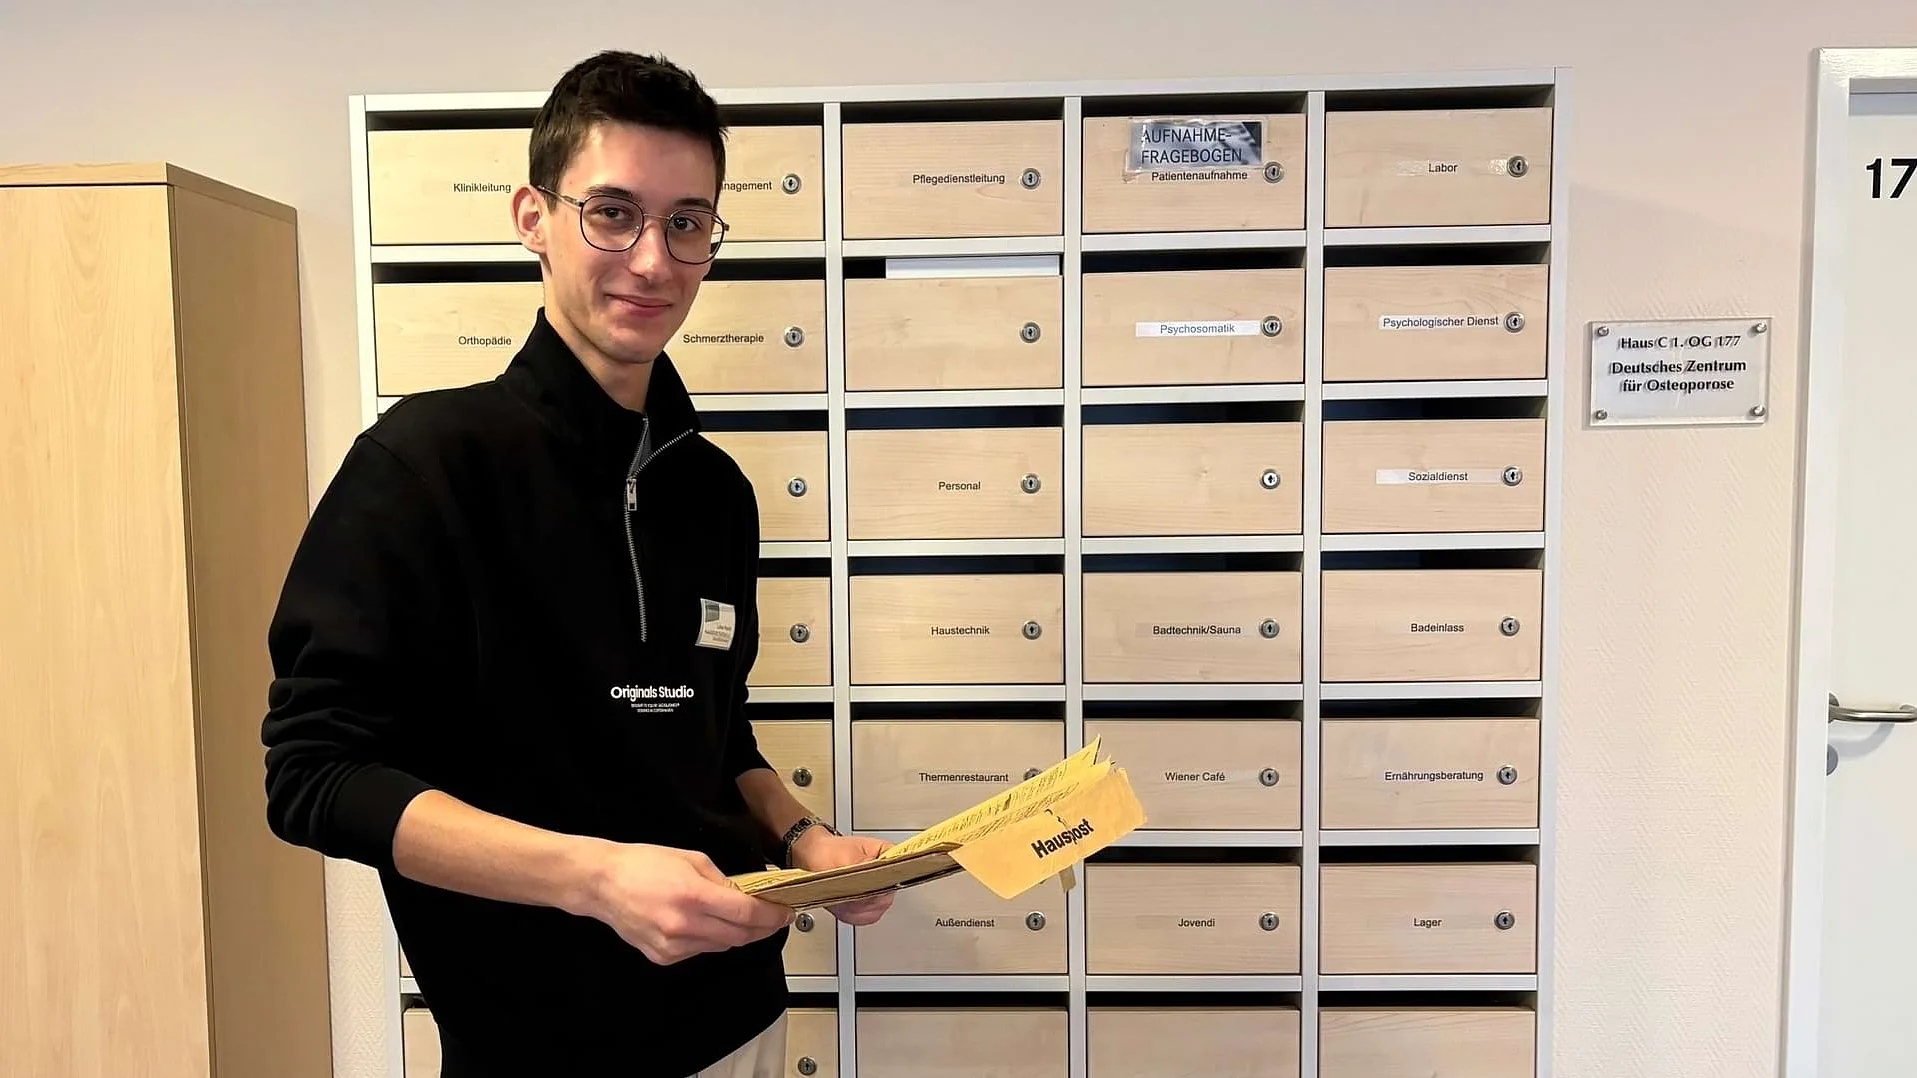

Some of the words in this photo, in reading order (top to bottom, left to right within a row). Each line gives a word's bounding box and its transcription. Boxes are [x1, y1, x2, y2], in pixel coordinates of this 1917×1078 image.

[1141, 127, 1232, 144] AUFNAHME-
[1141, 147, 1243, 164] FRAGEBOGEN
[1427, 162, 1459, 174] Labor
[912, 173, 1006, 186] Pflegedienstleitung
[1151, 170, 1249, 182] Patientenaufnahme
[452, 182, 512, 194] Klinikleitung
[722, 181, 773, 193] nagement
[1382, 316, 1464, 329] Psychologischer
[1466, 314, 1500, 327] Dienst
[1159, 323, 1236, 336] Psychosomatik
[457, 335, 513, 348] Orthopädie
[682, 333, 765, 346] Schmerztherapie
[1620, 337, 1654, 349] Haus
[1657, 337, 1668, 348] C
[1688, 336, 1712, 347] OG
[1717, 335, 1741, 346] 177
[1611, 360, 1683, 374] Deutsches
[1686, 360, 1747, 372] Zentrum
[1622, 380, 1642, 392] für
[1646, 379, 1735, 394] Osteoporose
[1407, 470, 1469, 482] Sozialdienst
[937, 481, 982, 492] Personal
[930, 624, 991, 636] Haustechnik
[1151, 623, 1242, 636] Badtechnik/Sauna
[1410, 622, 1465, 633] Badeinlass
[610, 685, 658, 702] Originals
[659, 685, 694, 699] Studio
[918, 771, 1010, 783] Thermenrestaurant
[1164, 771, 1200, 782] Wiener
[1202, 770, 1226, 782] Café
[1384, 769, 1485, 783] Ernährungsberatung
[934, 917, 996, 929] Außendienst
[1177, 916, 1216, 928] Jovendi
[1412, 917, 1443, 930] Lager
